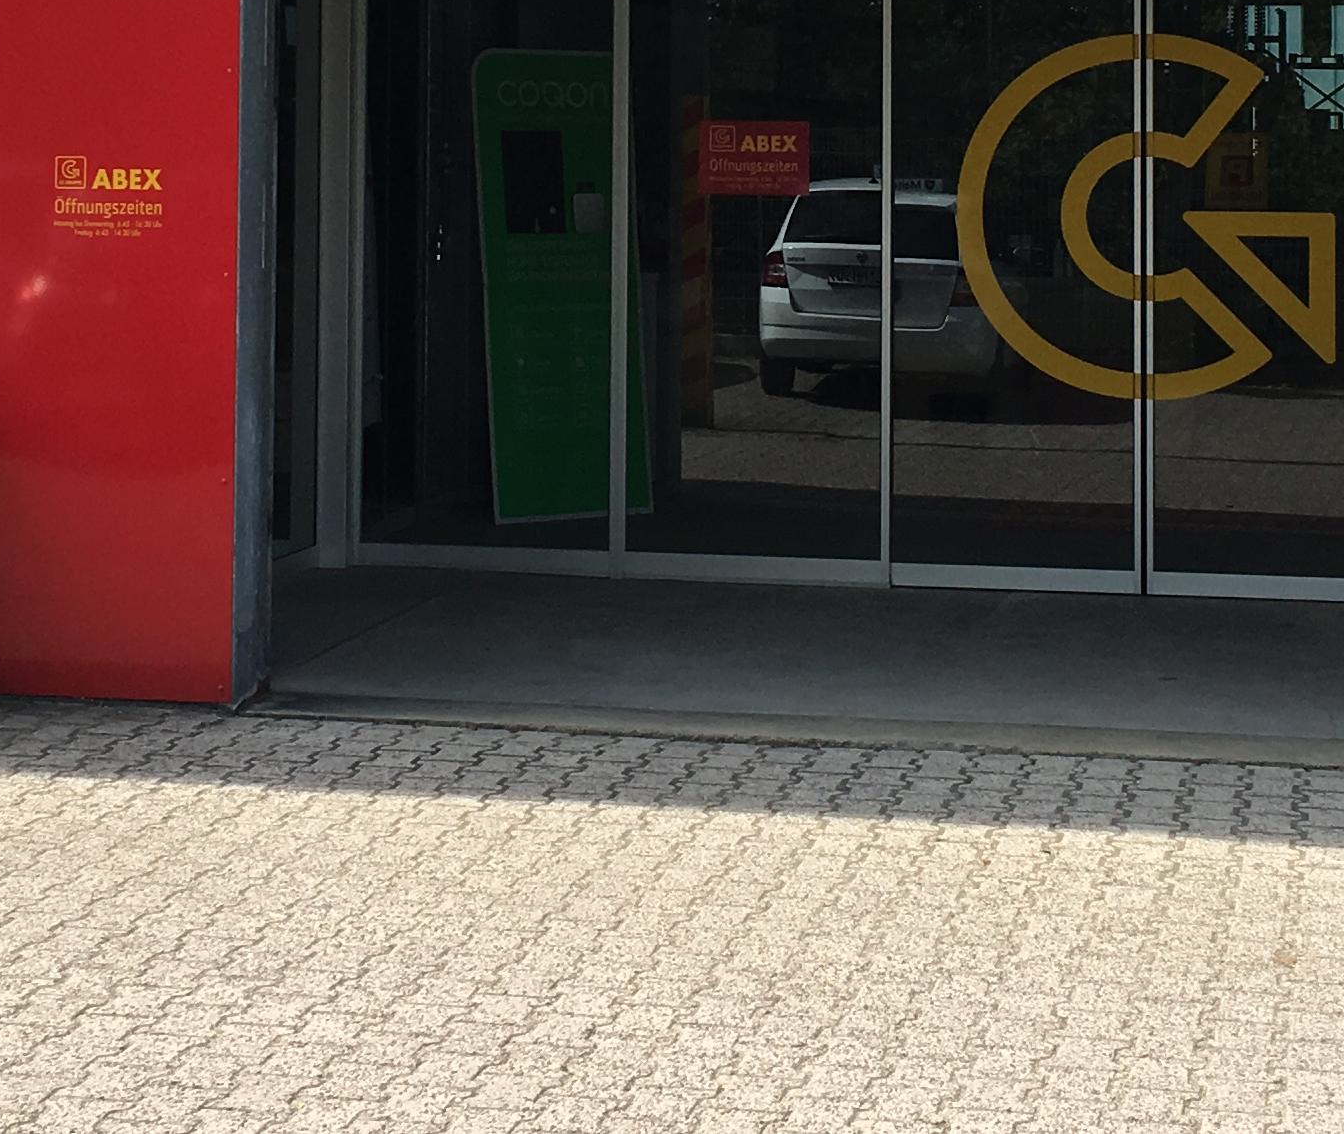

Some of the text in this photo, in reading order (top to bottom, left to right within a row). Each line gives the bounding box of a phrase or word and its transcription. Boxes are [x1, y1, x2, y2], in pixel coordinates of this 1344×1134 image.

[739, 134, 799, 153] ABEX
[92, 168, 163, 191] ABEX
[54, 196, 163, 218] Öffnungszeiten
